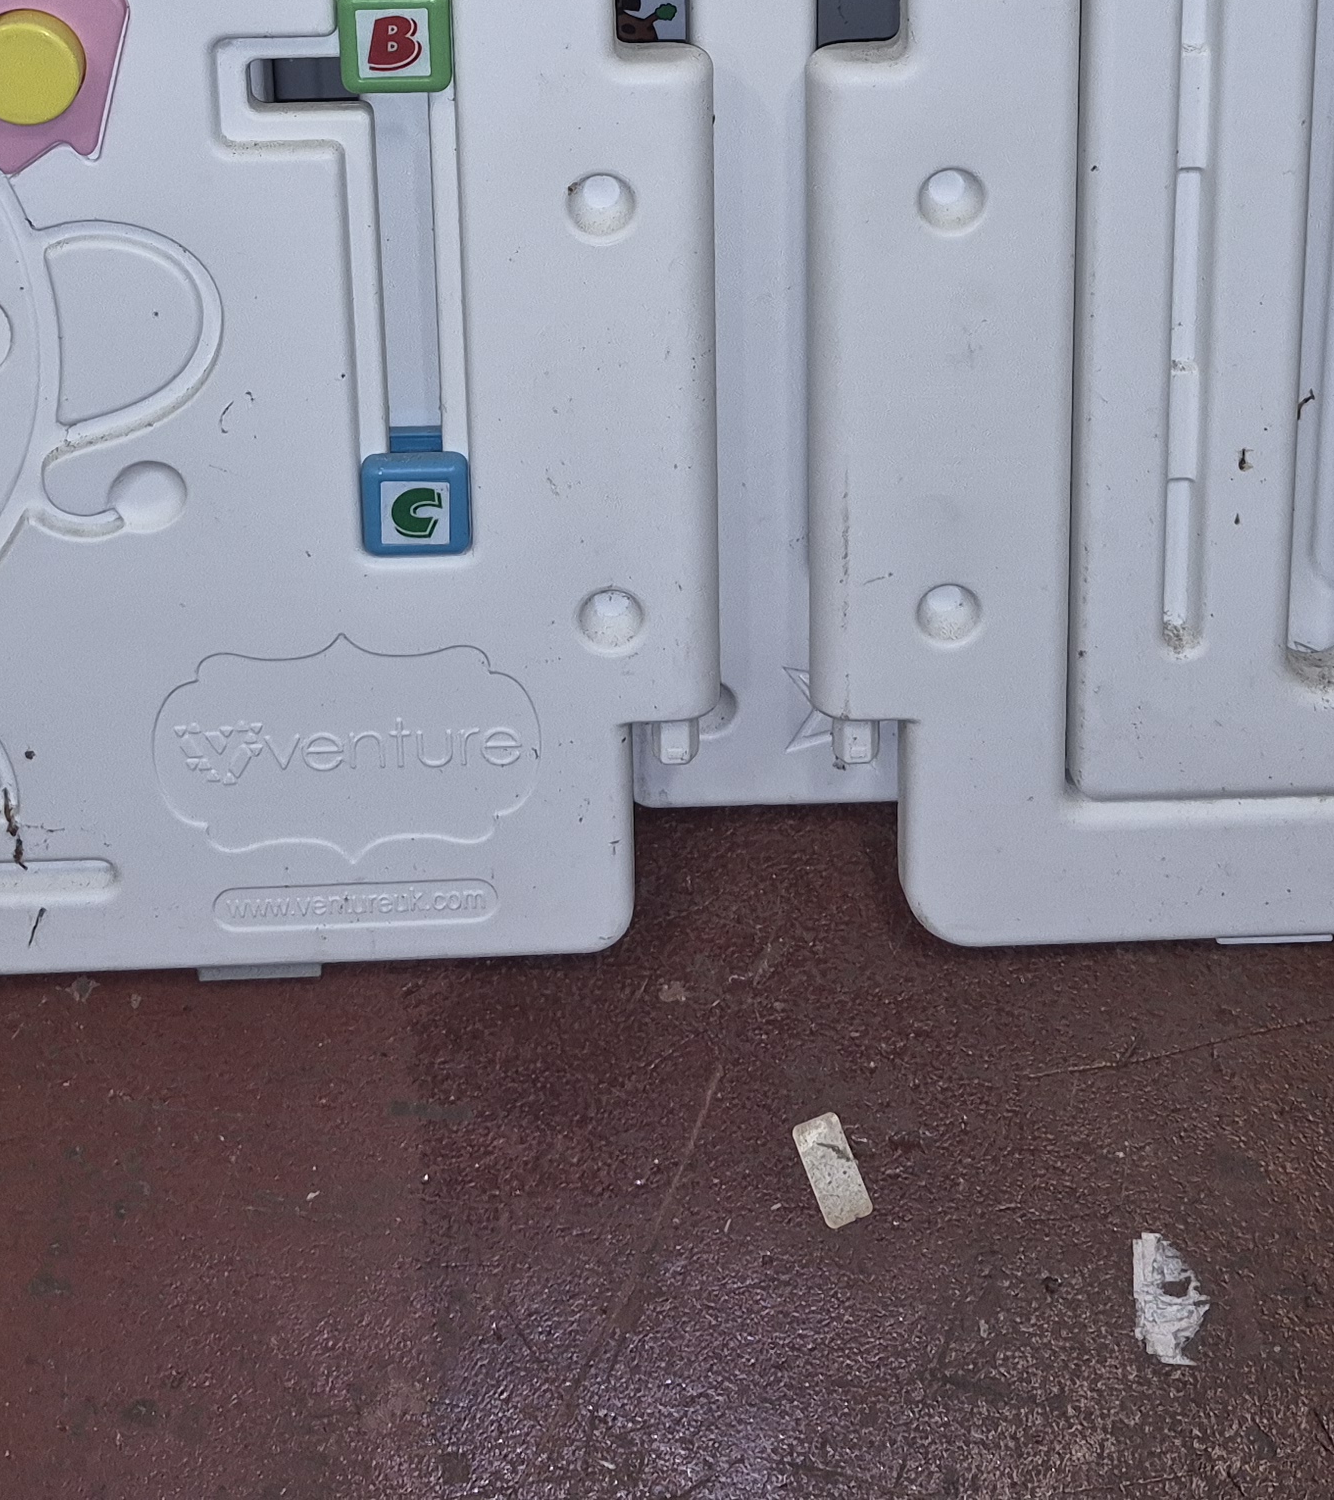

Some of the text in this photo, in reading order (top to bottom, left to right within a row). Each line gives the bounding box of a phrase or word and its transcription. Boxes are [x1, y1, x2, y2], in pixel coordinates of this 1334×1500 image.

[367, 15, 421, 72] B
[391, 487, 443, 538] C
[264, 717, 522, 771] venture
[226, 886, 487, 919] www.ventureuk.com
